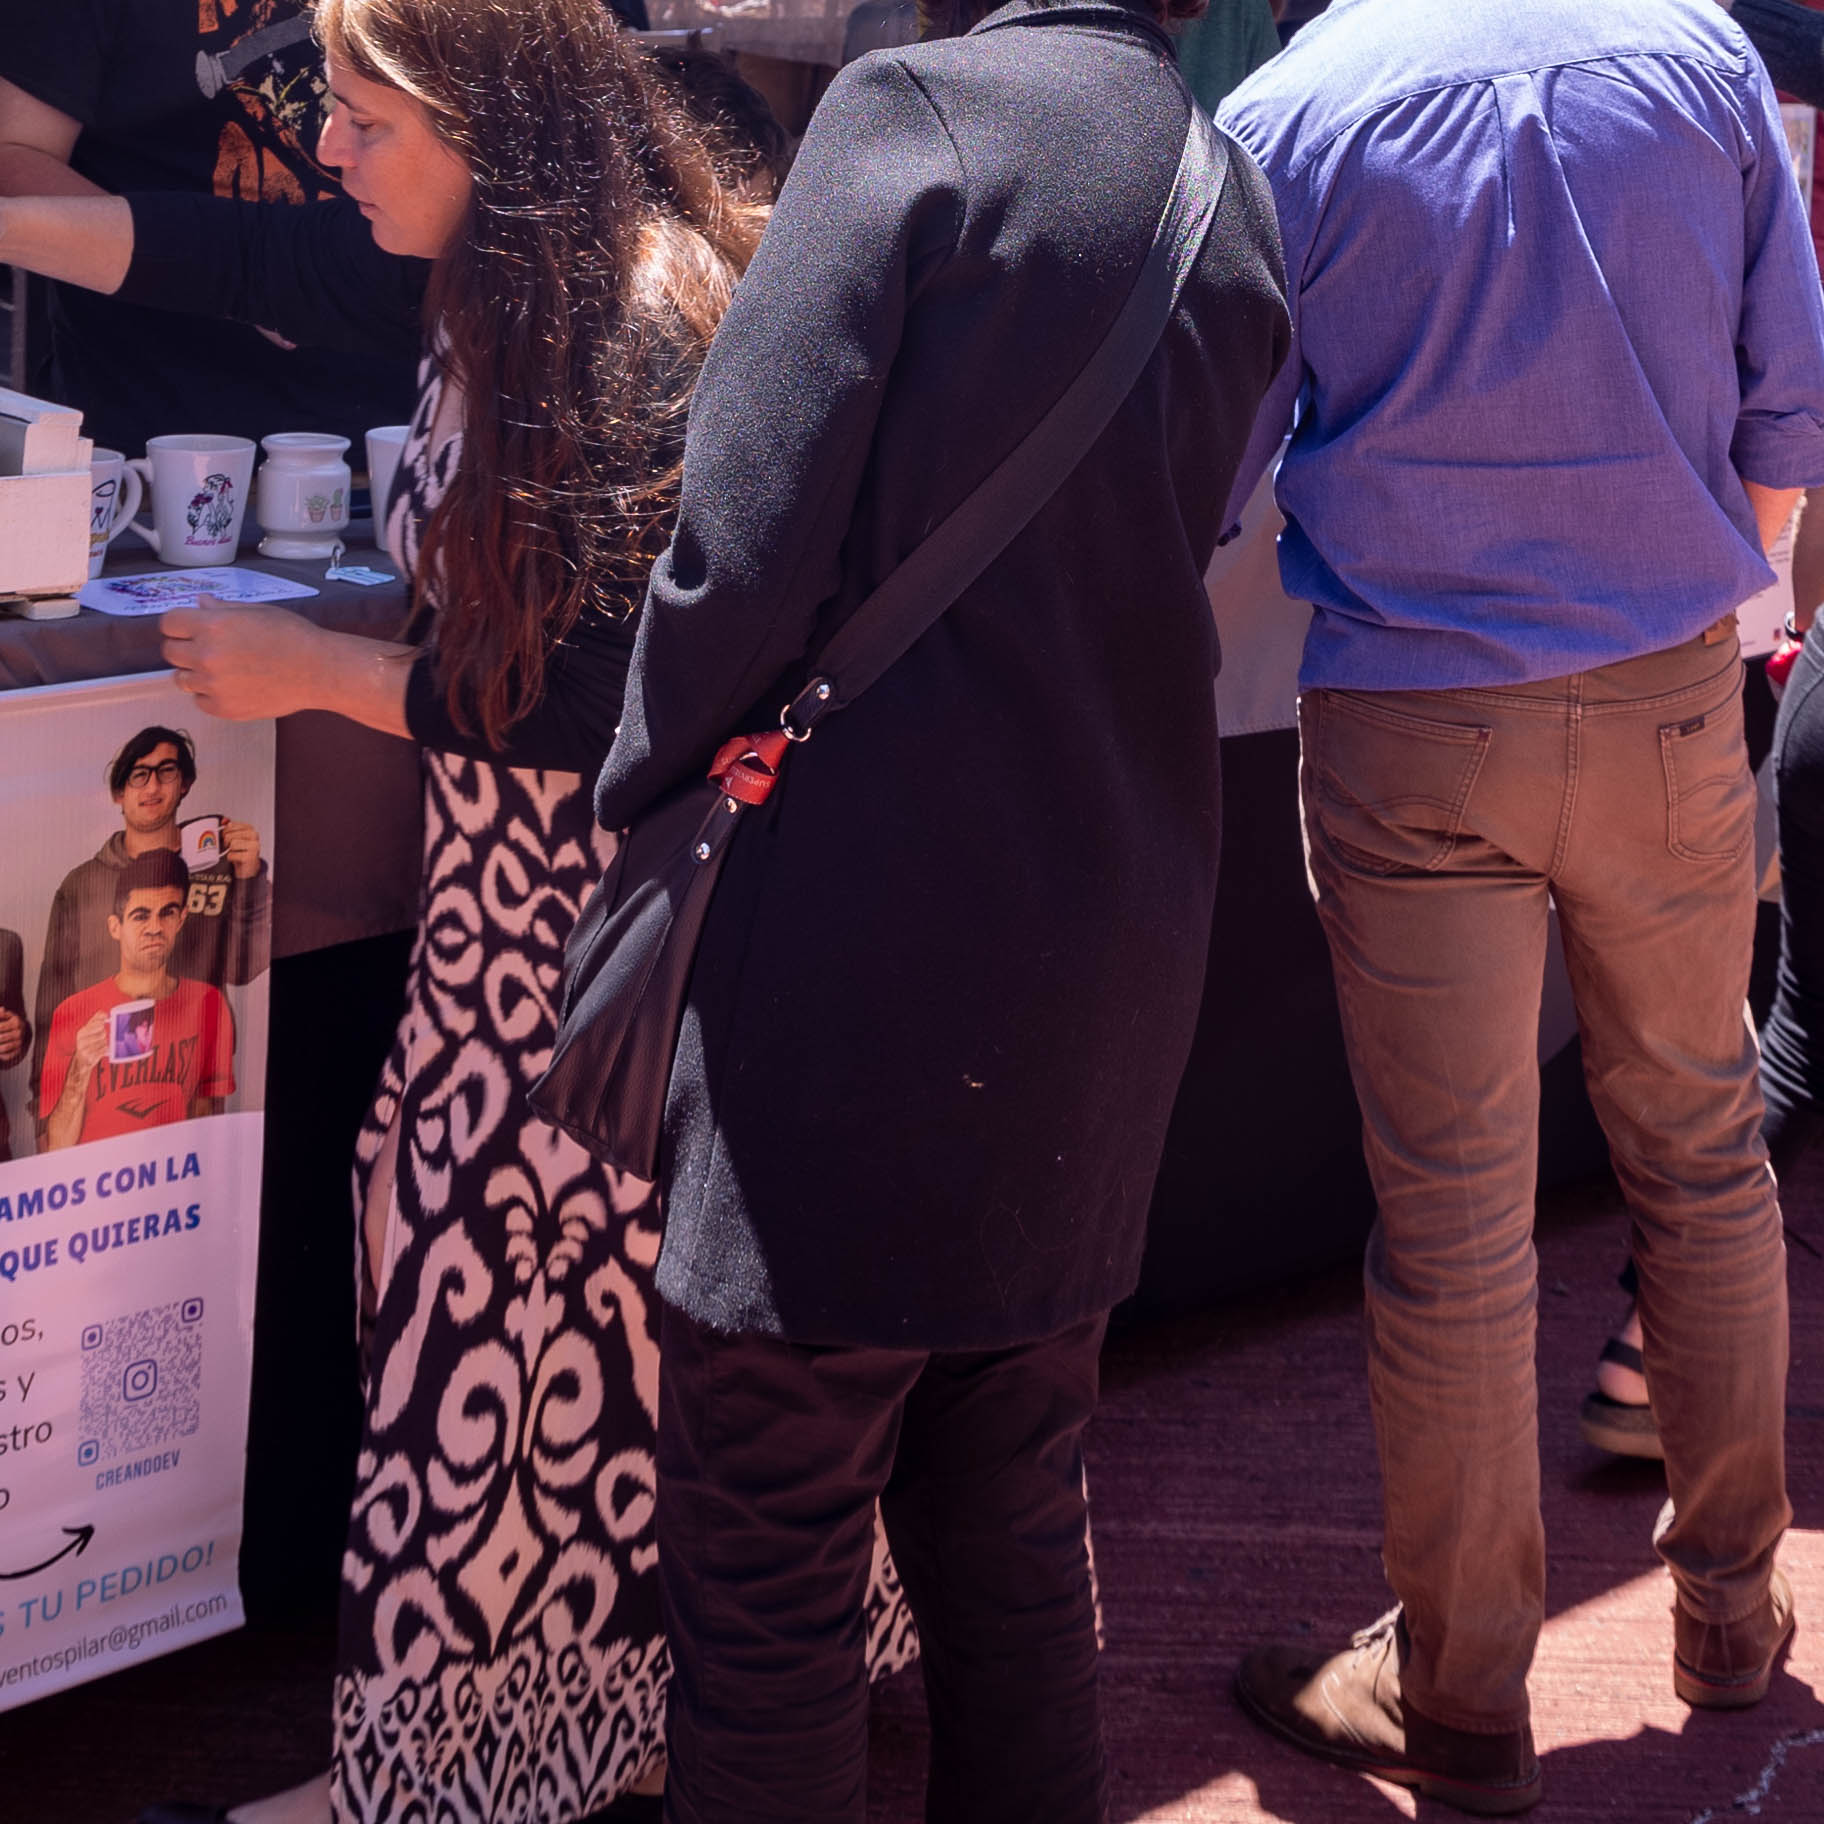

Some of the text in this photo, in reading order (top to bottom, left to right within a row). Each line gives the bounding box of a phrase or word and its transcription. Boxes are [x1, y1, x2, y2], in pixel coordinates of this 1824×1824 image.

[186, 883, 228, 916] 63
[95, 1160, 158, 1199] CON
[165, 1151, 202, 1184] LA
[67, 1203, 202, 1263] QUIERAS
[16, 1371, 36, 1407] y
[18, 1590, 64, 1629] TU
[75, 1540, 216, 1611] PEDIDO!
